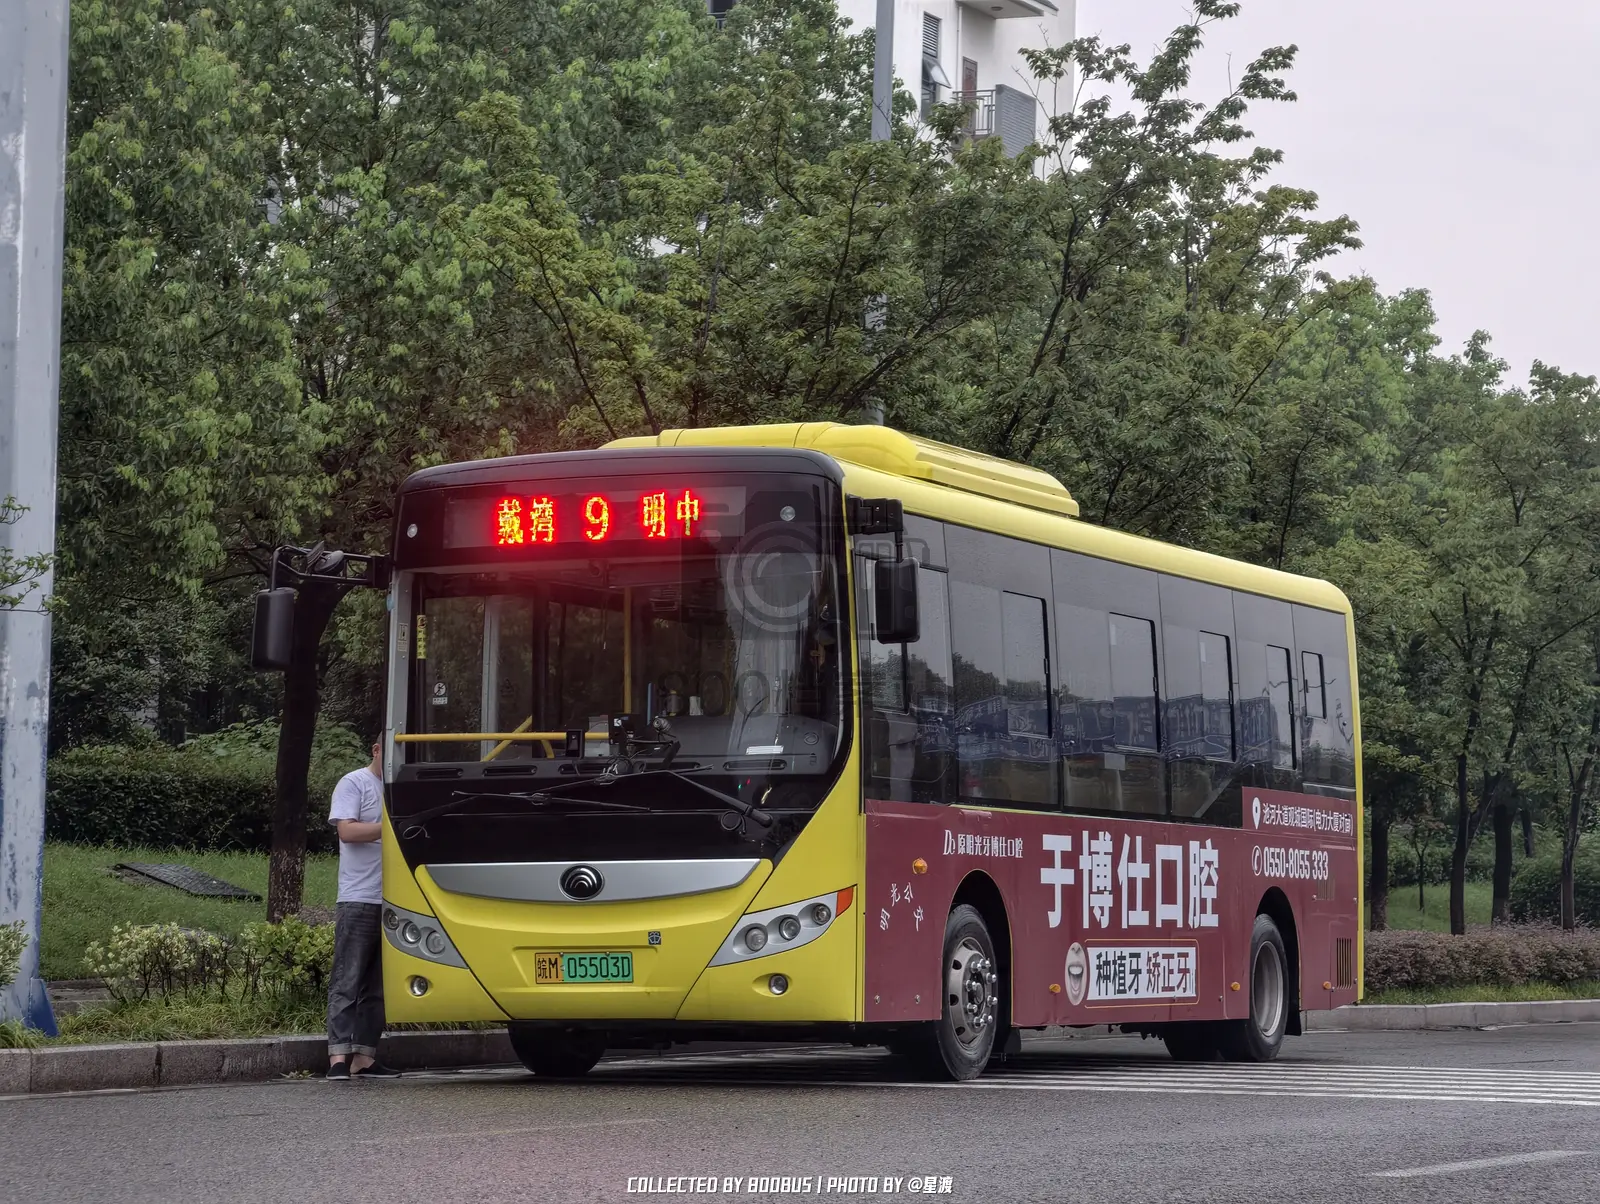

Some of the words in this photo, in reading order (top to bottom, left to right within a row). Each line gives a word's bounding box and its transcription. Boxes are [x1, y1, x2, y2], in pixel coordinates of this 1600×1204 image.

[585, 496, 610, 541] 9
[642, 490, 701, 538] 明中
[1040, 830, 1219, 930] 于博仕口腔
[567, 956, 631, 979] 05503D
[1095, 950, 1142, 996] 种植牙
[1146, 951, 1191, 994] 矫正牙
